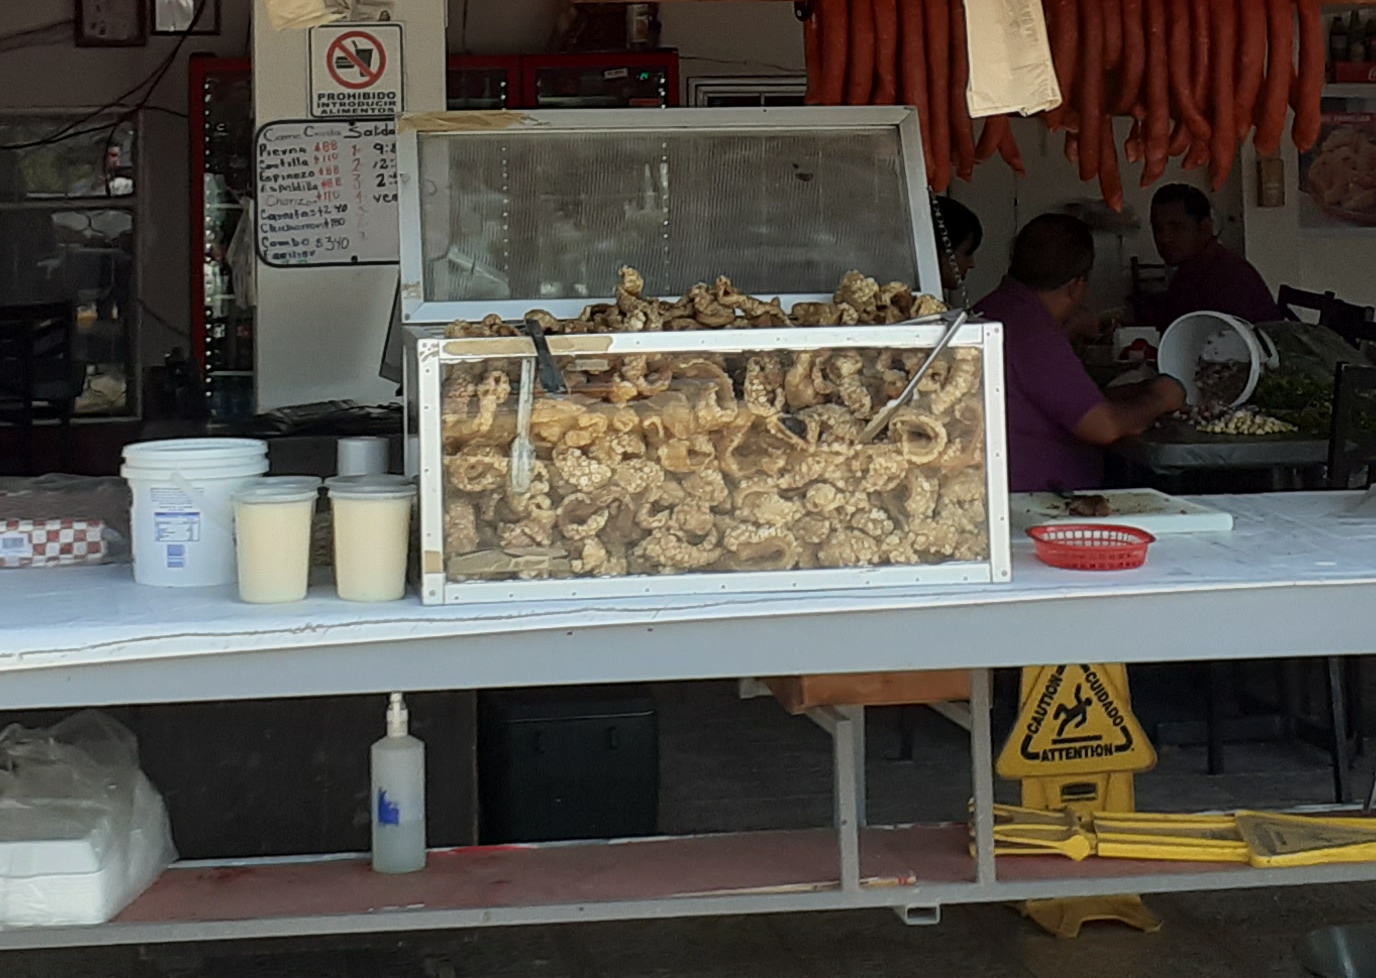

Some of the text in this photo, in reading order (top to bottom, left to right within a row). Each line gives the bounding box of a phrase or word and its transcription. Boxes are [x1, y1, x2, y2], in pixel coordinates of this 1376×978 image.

[317, 91, 397, 102] PROHIBIDO
[317, 100, 397, 109] INTRODUCIR
[320, 107, 396, 115] ALIMENTOS
[1026, 673, 1064, 735] CAUTION
[1085, 671, 1125, 727] CUIDADO
[1041, 743, 1113, 761] ATTENTION
